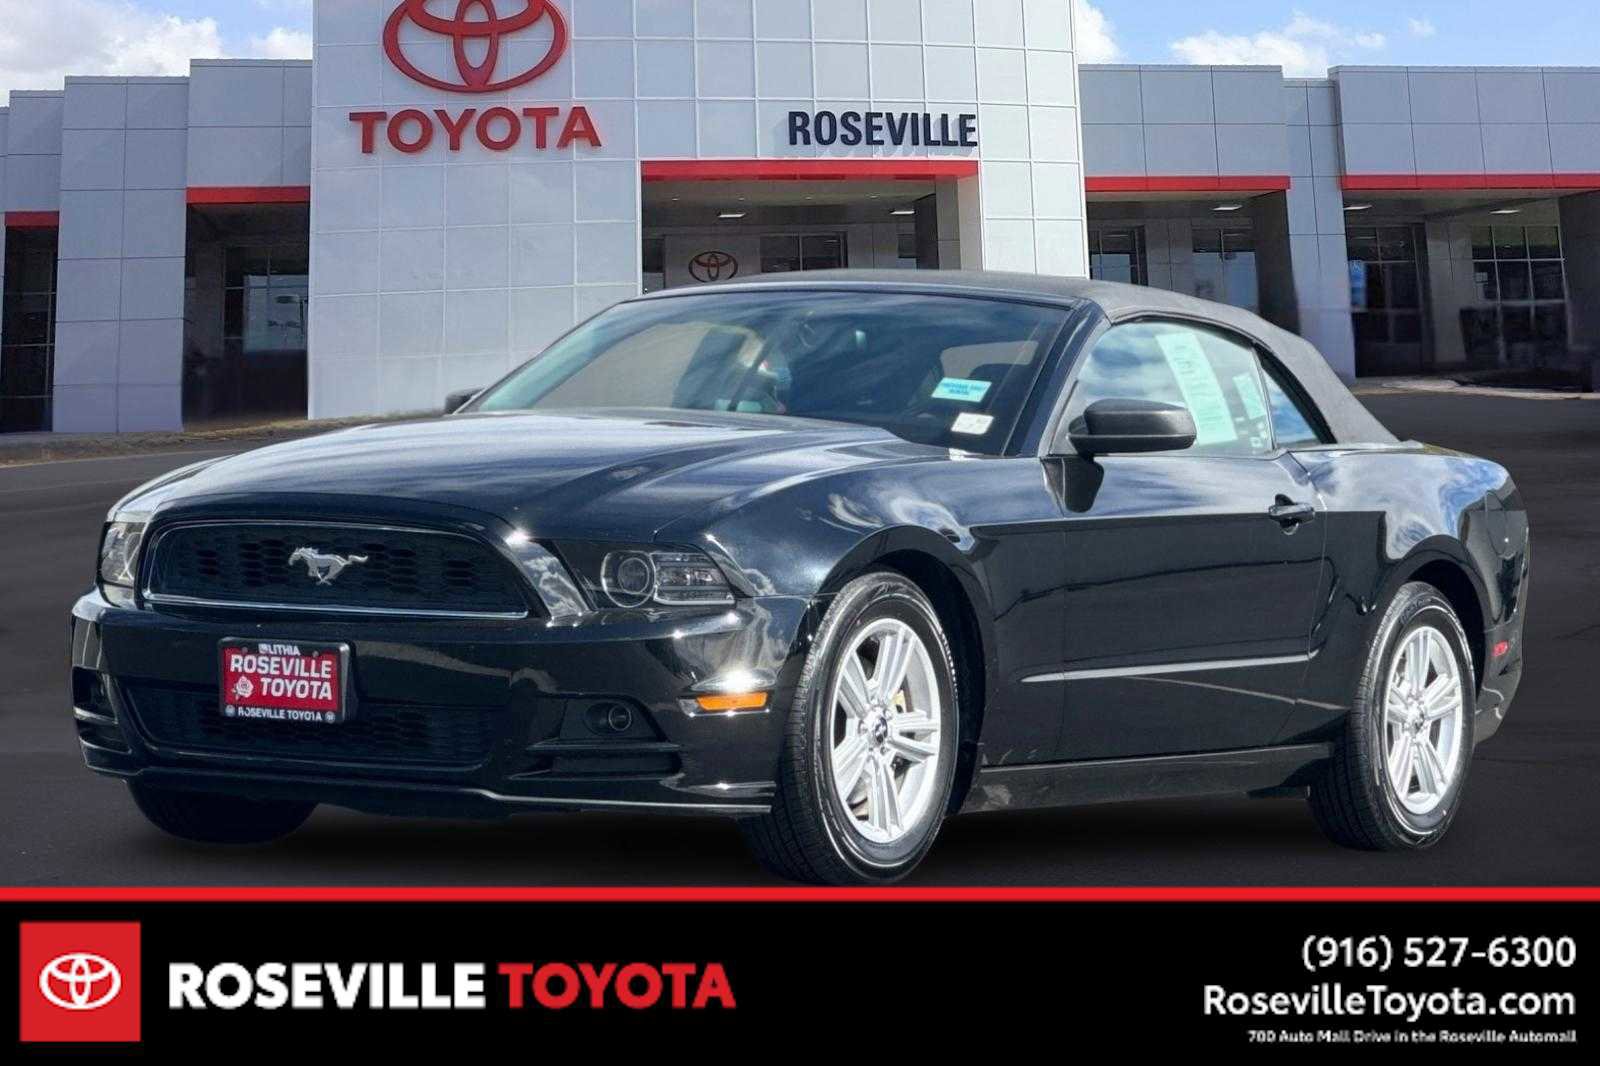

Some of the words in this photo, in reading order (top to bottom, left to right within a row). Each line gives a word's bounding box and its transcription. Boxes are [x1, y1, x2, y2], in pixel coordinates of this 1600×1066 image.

[349, 105, 602, 154] TOYOTA
[787, 110, 979, 147] ROSEVILLE
[267, 644, 300, 656] LITHIA
[229, 653, 333, 679] ROSEVILLE
[260, 677, 333, 701] TOYOTA
[237, 706, 286, 720] ROSEVILLE
[287, 709, 323, 721] TOYOTA
